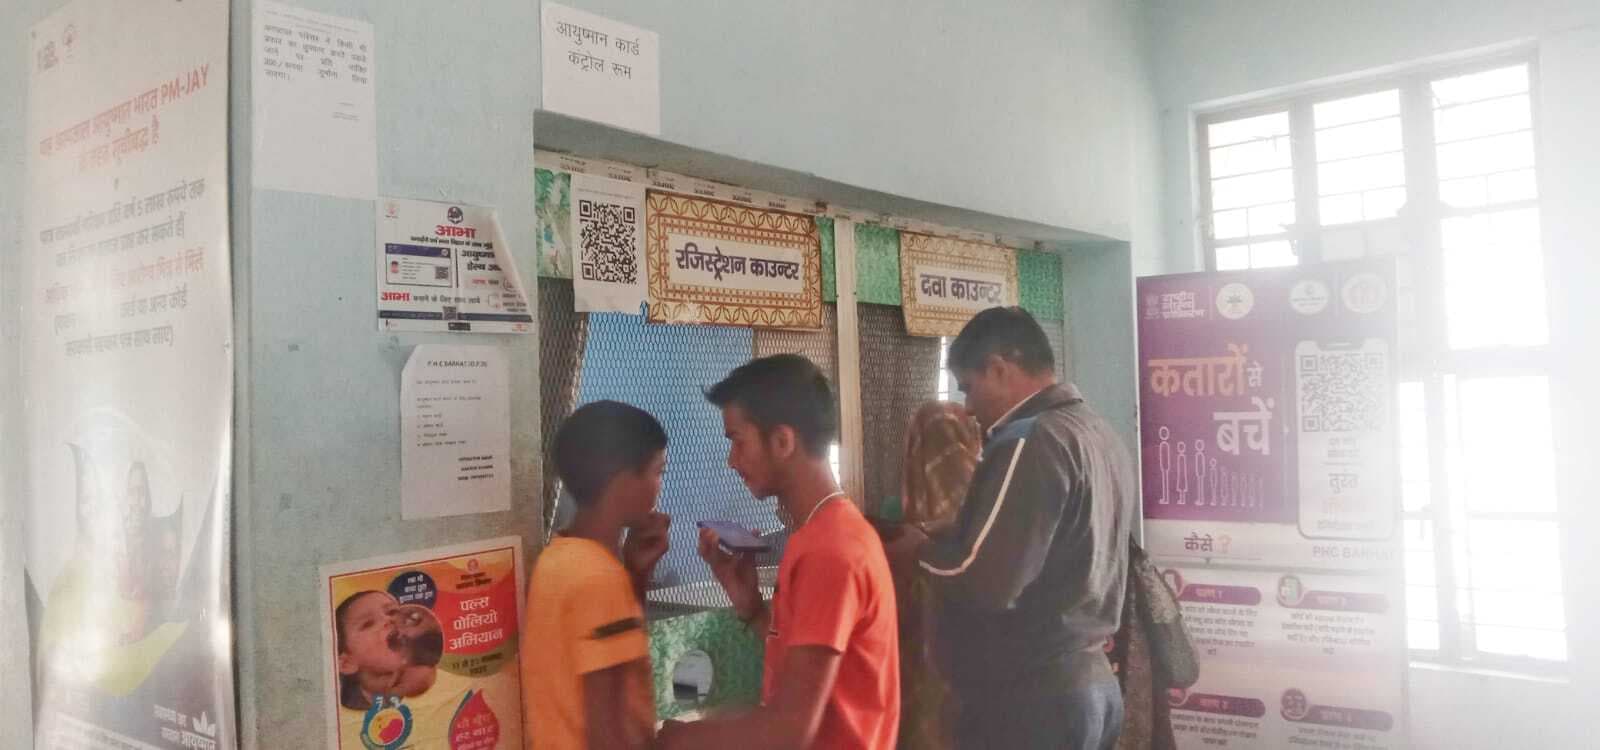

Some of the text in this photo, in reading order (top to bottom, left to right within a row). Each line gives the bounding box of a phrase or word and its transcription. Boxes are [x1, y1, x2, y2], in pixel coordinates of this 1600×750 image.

[556, 21, 640, 56] आयुष्मान कार्ड
[612, 62, 632, 80] रूम
[160, 63, 209, 105] PM-JAY
[435, 224, 477, 239] आभा
[675, 242, 799, 282] रजिस्ट्रेशन काउन्टर
[920, 272, 947, 298] दवा
[381, 291, 411, 302] आभा
[1148, 343, 1264, 397] कतारों से
[1213, 396, 1276, 455] बचें
[1184, 532, 1213, 553] कैसे
[460, 596, 490, 611] पल्स
[453, 611, 498, 631] पोलियो
[449, 628, 503, 650] अभियान
